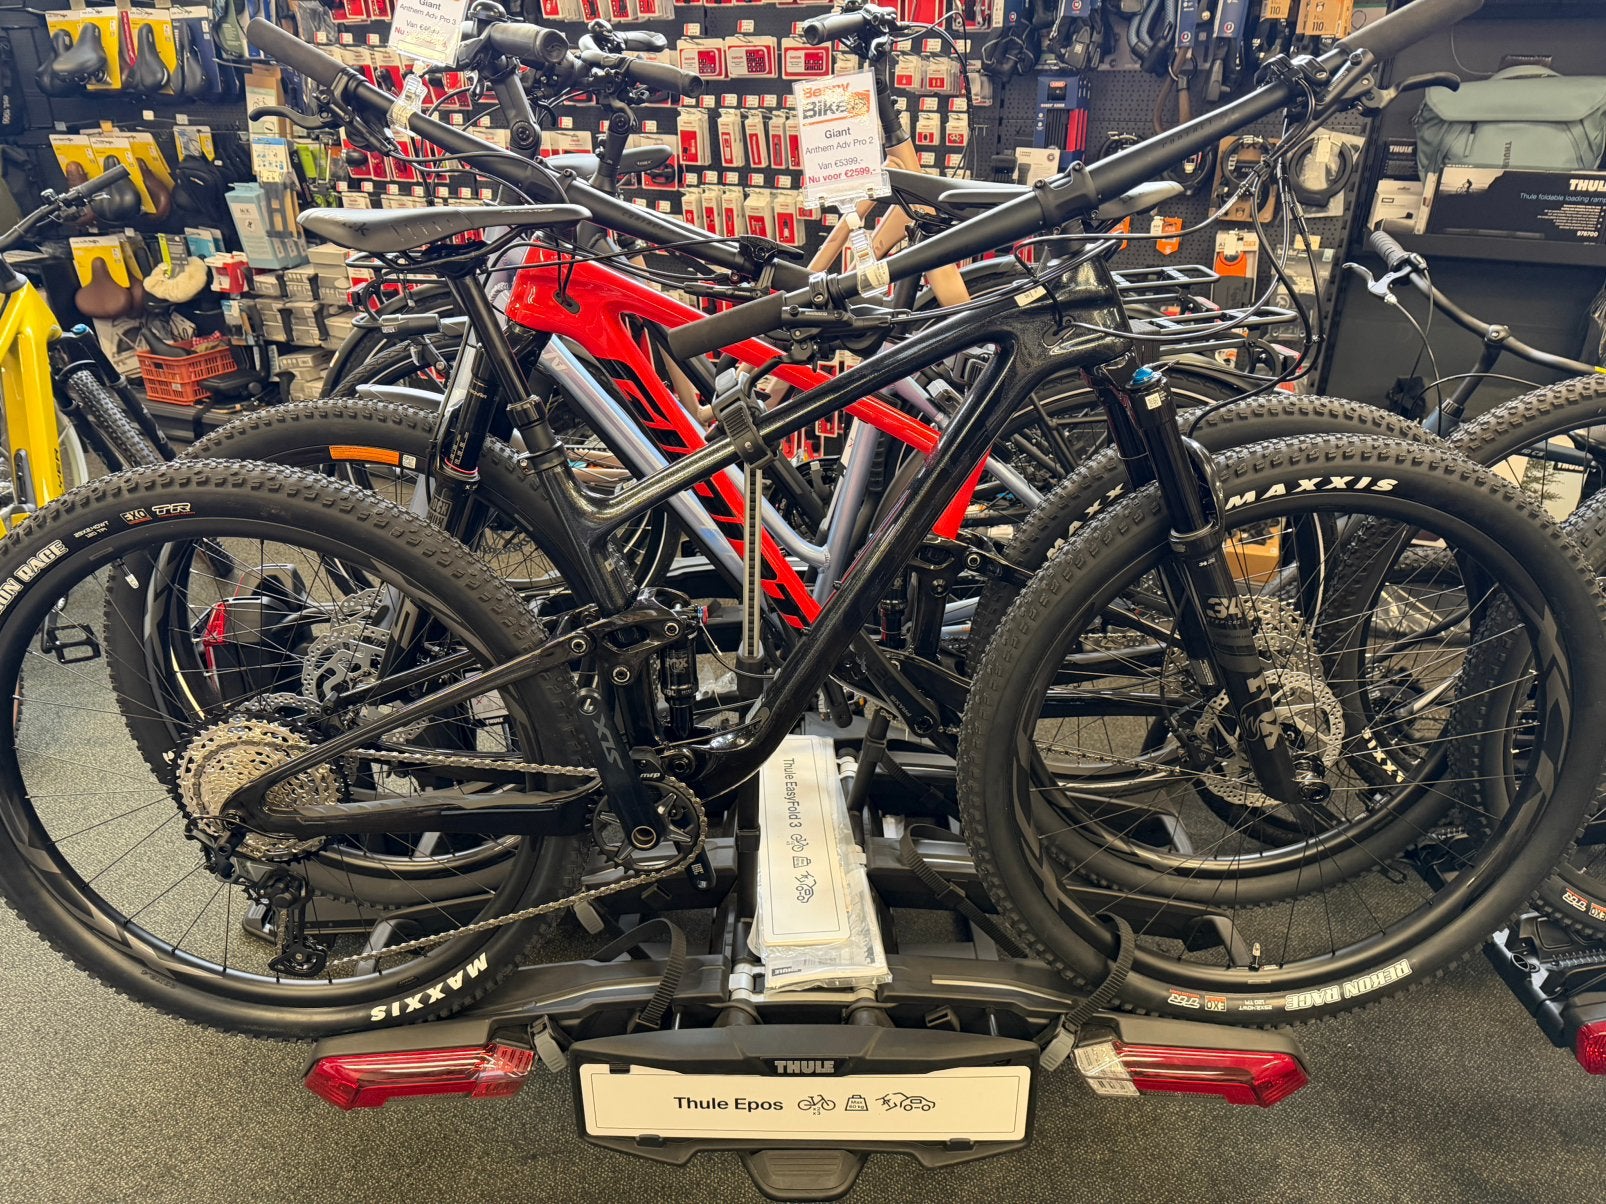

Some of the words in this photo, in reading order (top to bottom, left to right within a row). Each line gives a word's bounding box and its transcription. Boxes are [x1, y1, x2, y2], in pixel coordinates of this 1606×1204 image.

[400, 3, 424, 16] Anthem
[419, 0, 442, 10] Giant
[1312, 21, 1325, 32] 110
[824, 126, 852, 140] Giant
[805, 142, 836, 156] Anthem
[836, 141, 851, 150] Adv
[853, 138, 867, 147] Pro
[868, 136, 875, 144] 2
[1389, 145, 1414, 154] THULE
[818, 161, 833, 170] Van
[834, 157, 865, 168] €5399,-
[808, 174, 821, 185] Nu
[823, 173, 842, 182] voor
[844, 166, 877, 178] €2599,-
[1569, 178, 1606, 192] THUL
[1519, 192, 1538, 201] Thule
[1540, 193, 1564, 201] foldable
[1565, 194, 1590, 203] loading
[1224, 476, 1399, 511] MAXXIS
[122, 509, 150, 523] EXO
[152, 502, 192, 517] TR
[1046, 482, 1126, 560] MAXX
[13, 539, 70, 583] RACE
[1205, 597, 1242, 620] 34
[639, 771, 661, 779] mrp
[783, 757, 797, 781] Thule
[784, 781, 802, 825] EasyFold
[370, 951, 489, 1022] MAXXIS
[1343, 958, 1413, 999] REKON
[1167, 993, 1201, 1009] TR
[1205, 1000, 1227, 1012] EXO
[1284, 984, 1342, 1012] RACE
[774, 1060, 835, 1074] THULE
[673, 1096, 729, 1110] Thule
[734, 1097, 784, 1113] Epos
